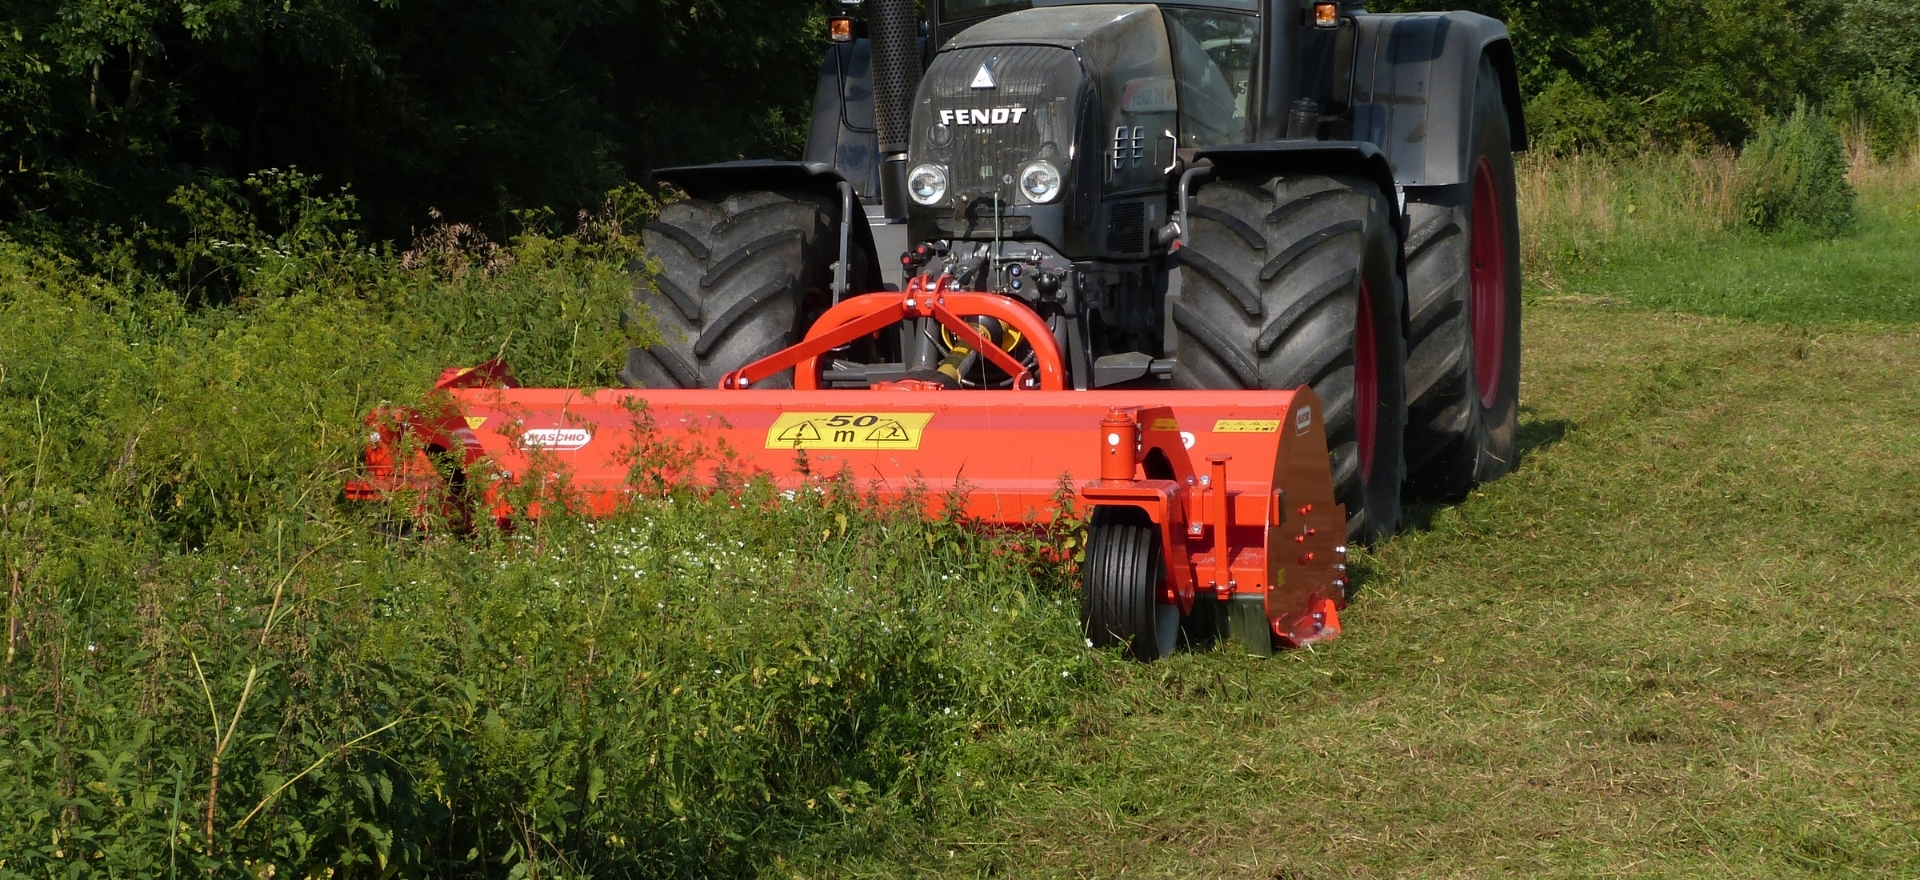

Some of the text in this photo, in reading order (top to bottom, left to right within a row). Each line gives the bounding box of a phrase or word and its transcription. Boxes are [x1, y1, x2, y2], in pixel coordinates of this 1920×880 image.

[939, 107, 1027, 125] FENDT
[826, 415, 879, 428] 50
[527, 433, 585, 442] MASCHIO
[833, 429, 855, 443] m
